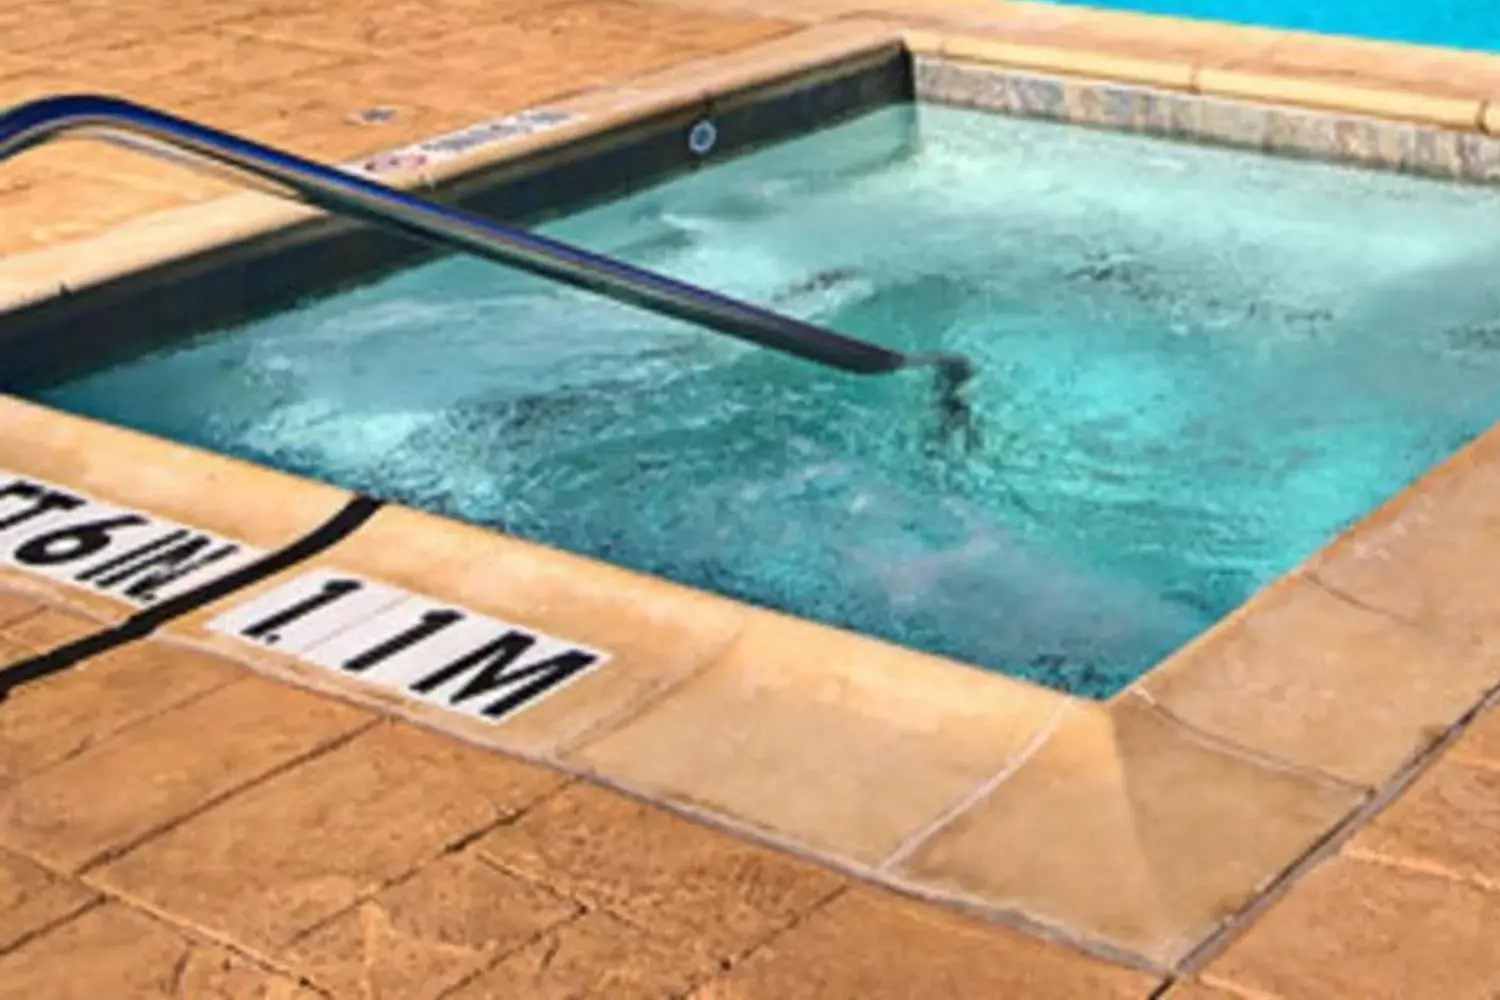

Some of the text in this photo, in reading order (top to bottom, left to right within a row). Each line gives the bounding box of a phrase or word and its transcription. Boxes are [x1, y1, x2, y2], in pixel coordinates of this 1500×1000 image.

[0, 480, 87, 529] T
[14, 513, 150, 564] 6
[409, 630, 598, 719] M
